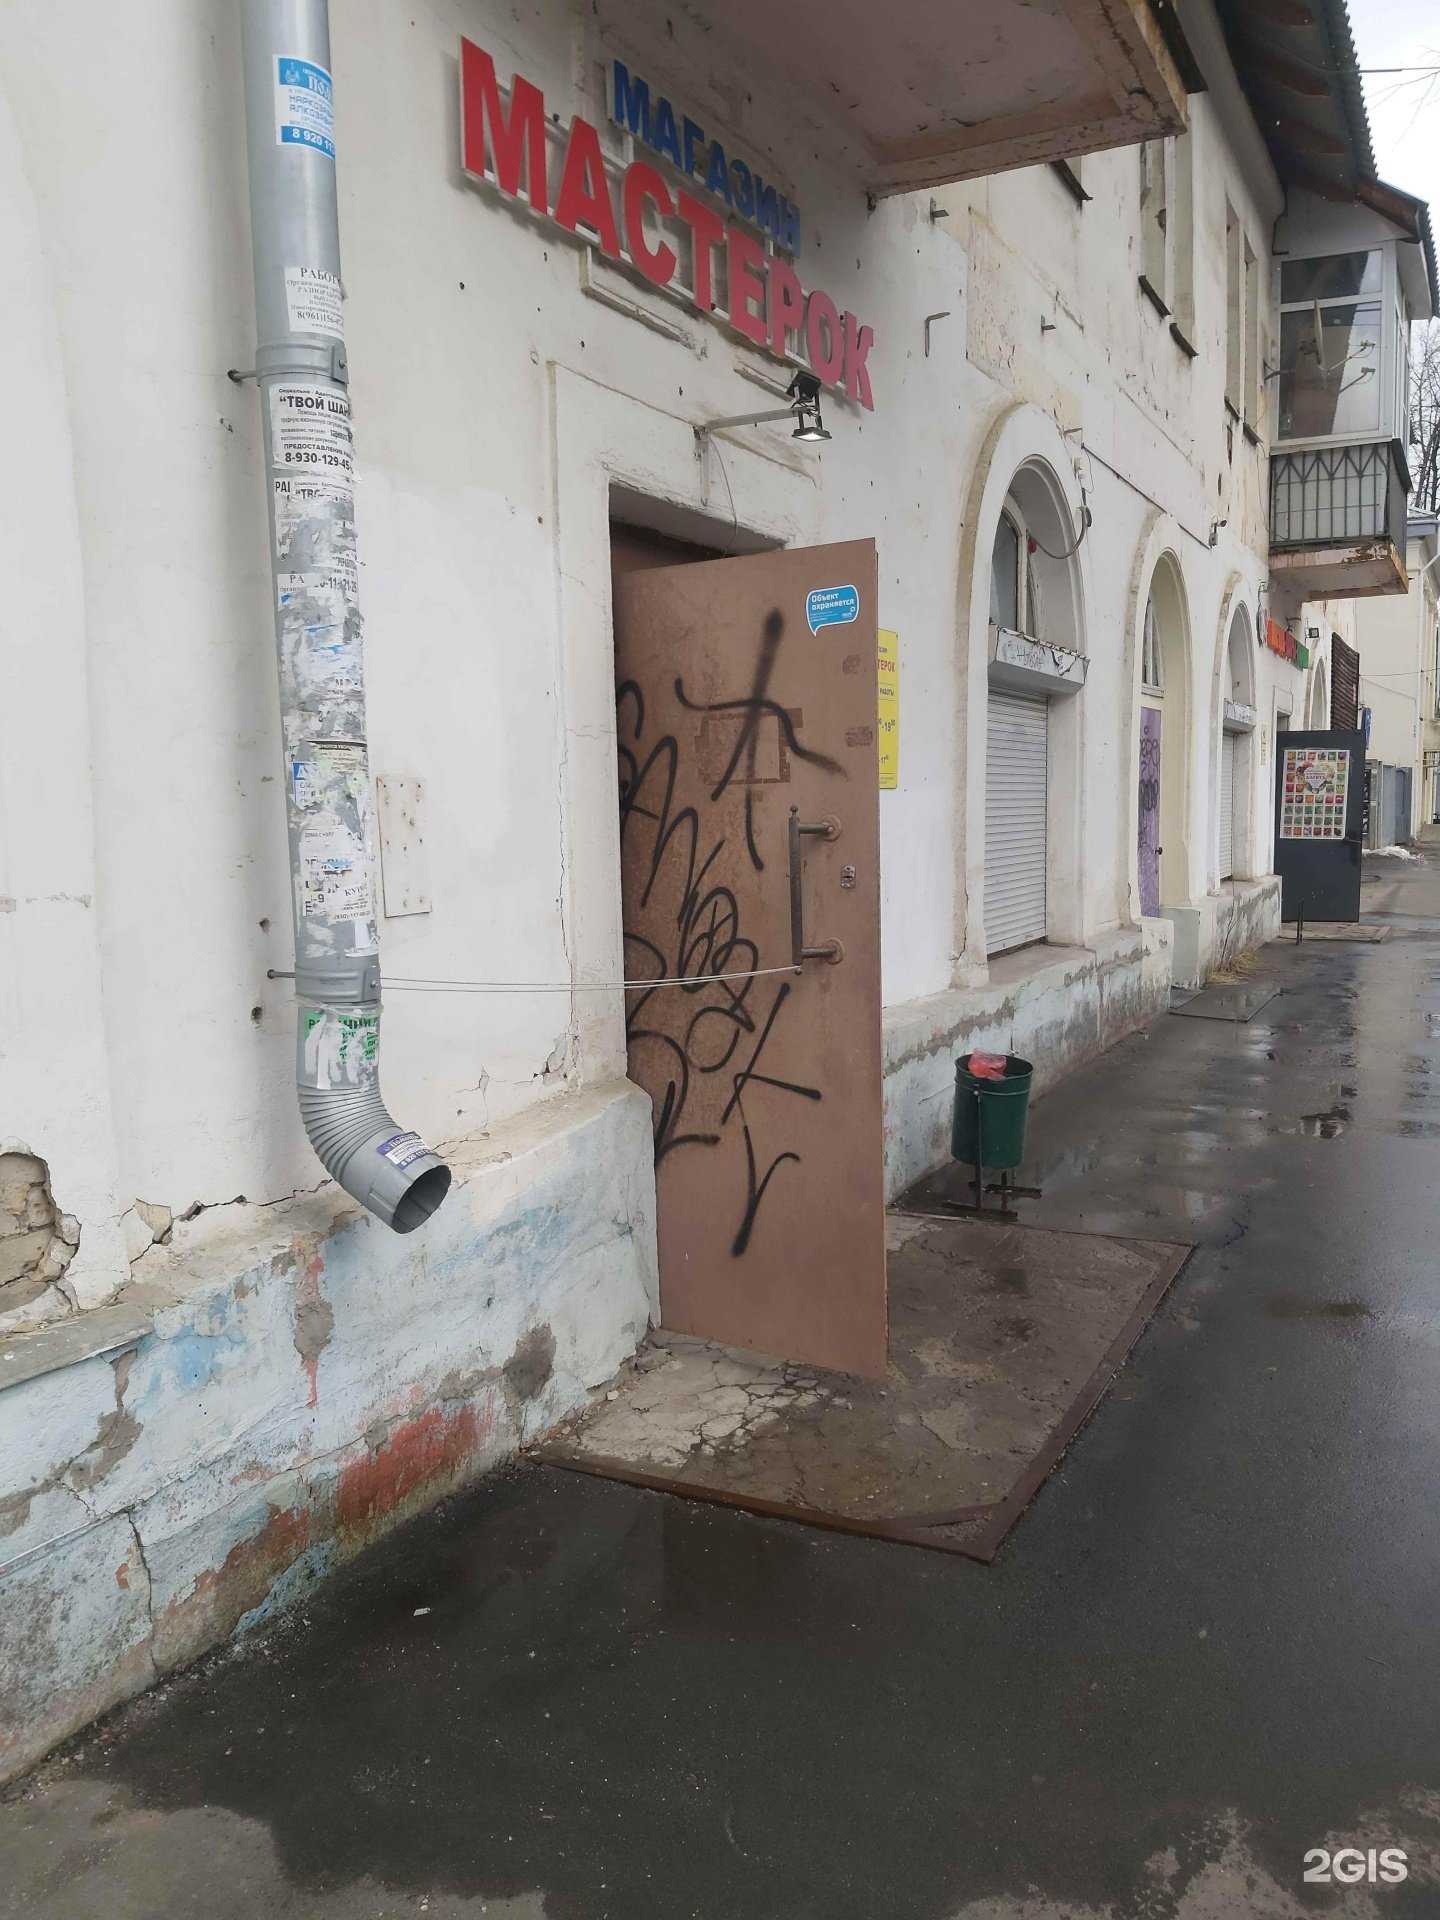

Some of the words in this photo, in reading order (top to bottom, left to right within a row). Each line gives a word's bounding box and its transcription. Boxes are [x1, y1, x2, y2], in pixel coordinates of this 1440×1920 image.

[292, 128, 301, 139] 8
[303, 131, 323, 146] 920
[613, 58, 801, 257] МАГАЗИН
[461, 35, 875, 412] МАСТЕРОК
[811, 593, 840, 603] Объект
[811, 598, 854, 611] охраняется
